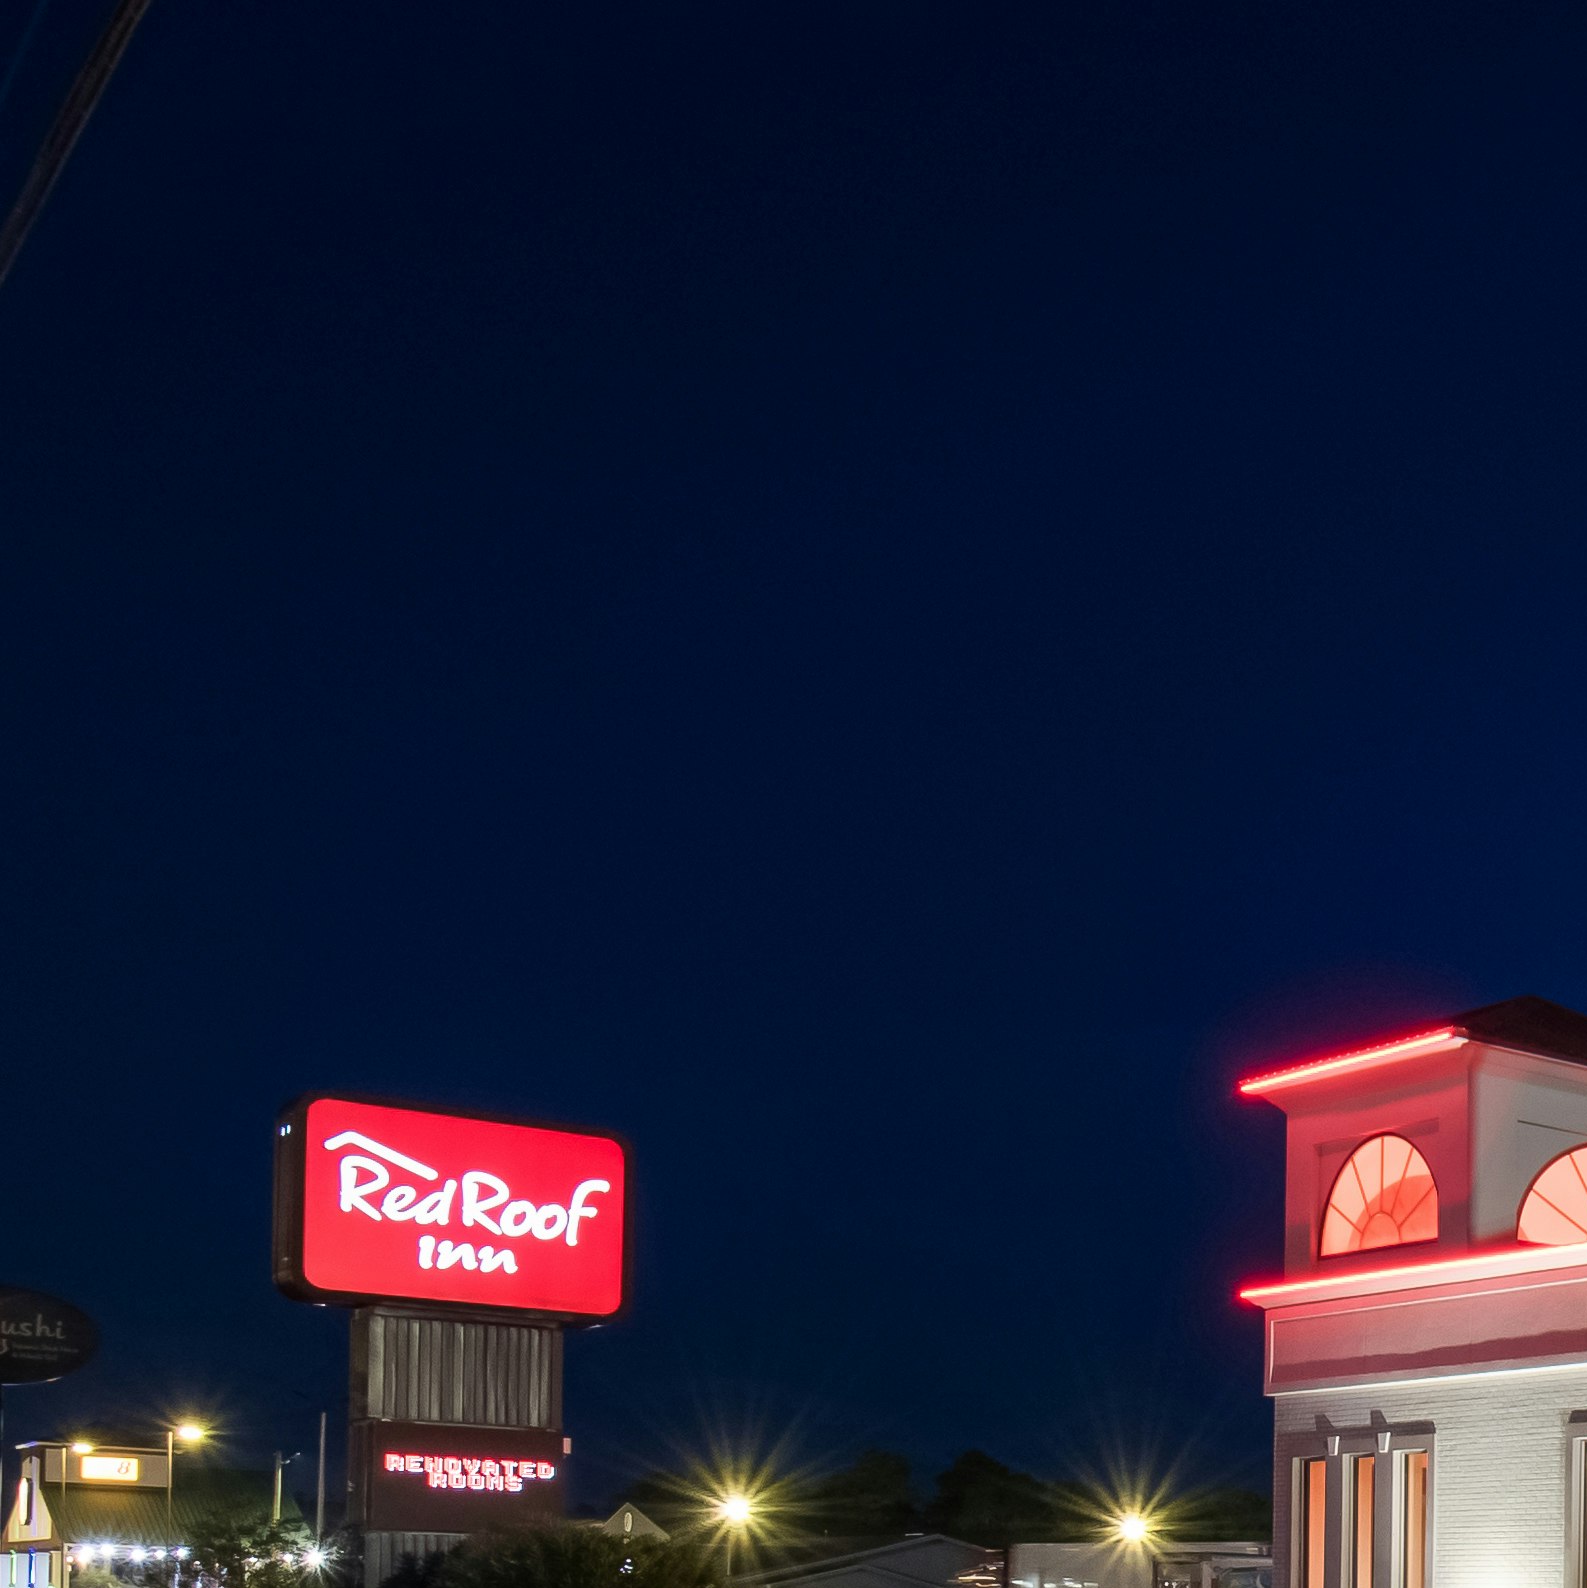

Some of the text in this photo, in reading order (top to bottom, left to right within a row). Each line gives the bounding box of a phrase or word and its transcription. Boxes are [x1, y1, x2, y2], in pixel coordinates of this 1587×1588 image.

[339, 1154, 611, 1247] Red Roof
[384, 1453, 556, 1480] RENOVATED
[427, 1471, 524, 1493] ROOMS
